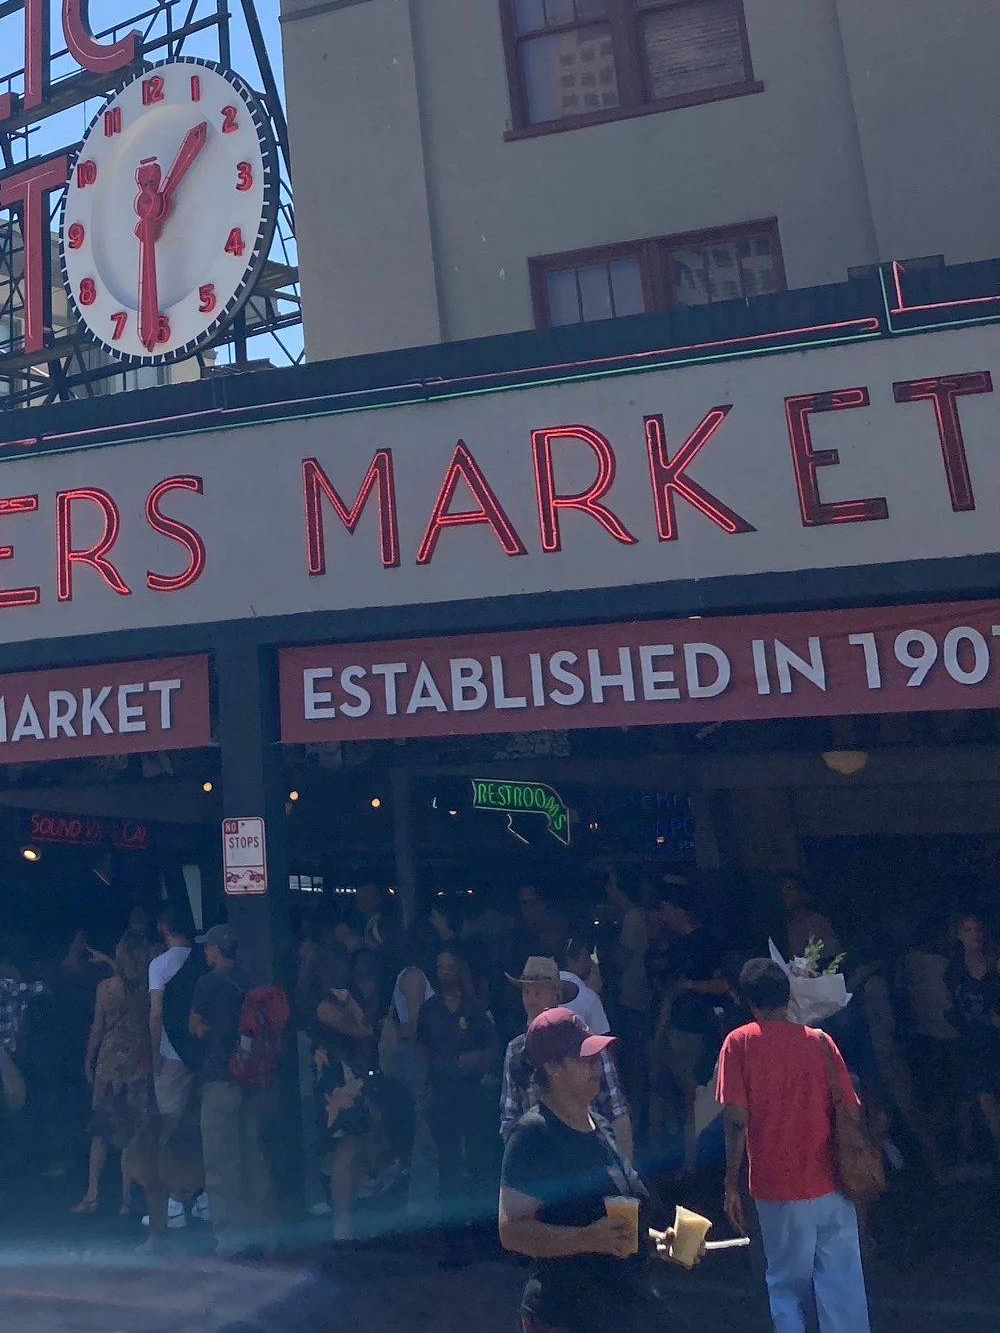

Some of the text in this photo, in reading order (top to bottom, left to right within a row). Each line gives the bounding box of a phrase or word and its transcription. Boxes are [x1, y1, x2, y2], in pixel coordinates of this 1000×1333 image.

[142, 75, 165, 106] 12
[191, 75, 200, 102] 1
[104, 106, 121, 138] 11
[221, 105, 239, 134] 2
[77, 159, 97, 189] 10
[235, 161, 253, 192] 3
[68, 222, 85, 250] 9
[224, 227, 246, 257] 4
[79, 277, 97, 306] 8
[198, 283, 216, 313] 5
[110, 311, 128, 341] 7
[301, 370, 994, 576] MARKET
[303, 625, 1000, 720] ESTABLISHED IN 190
[477, 783, 567, 831] RESTROOMS
[225, 822, 237, 833] NO
[228, 836, 260, 849] STOPS
